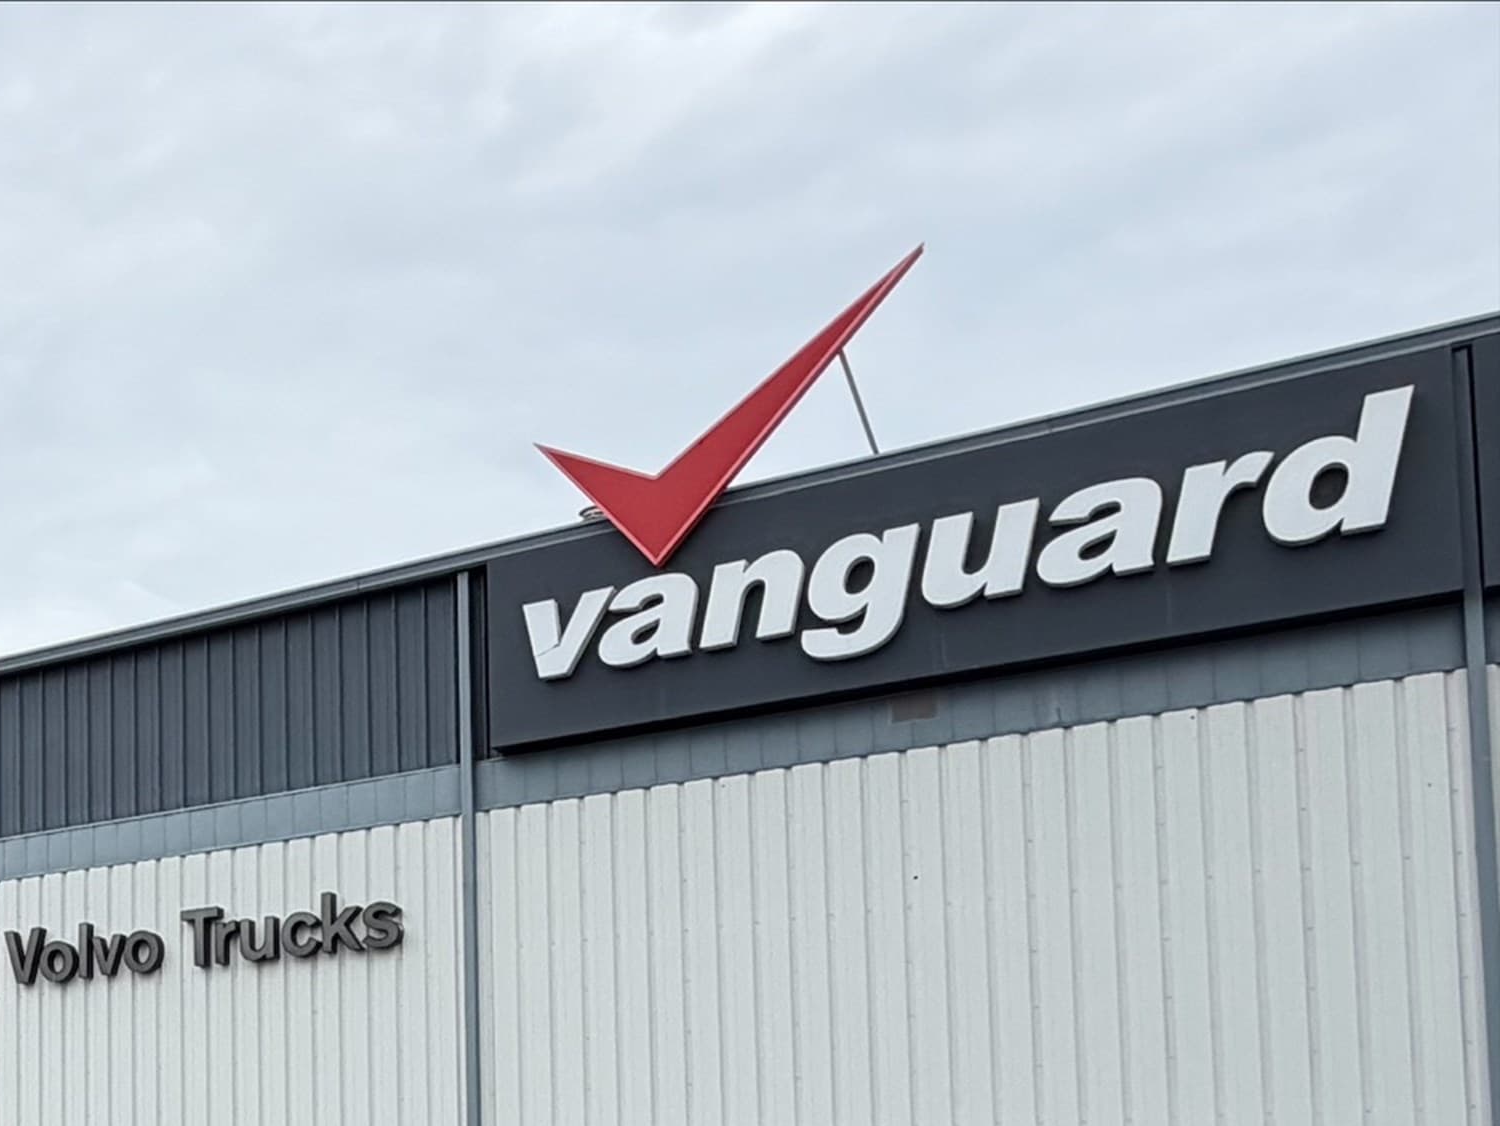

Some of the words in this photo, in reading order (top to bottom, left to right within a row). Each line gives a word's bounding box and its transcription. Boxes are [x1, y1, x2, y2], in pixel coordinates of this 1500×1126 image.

[521, 384, 1414, 682] vanguard
[4, 922, 165, 985] Volvo
[181, 892, 404, 968] Trucks
